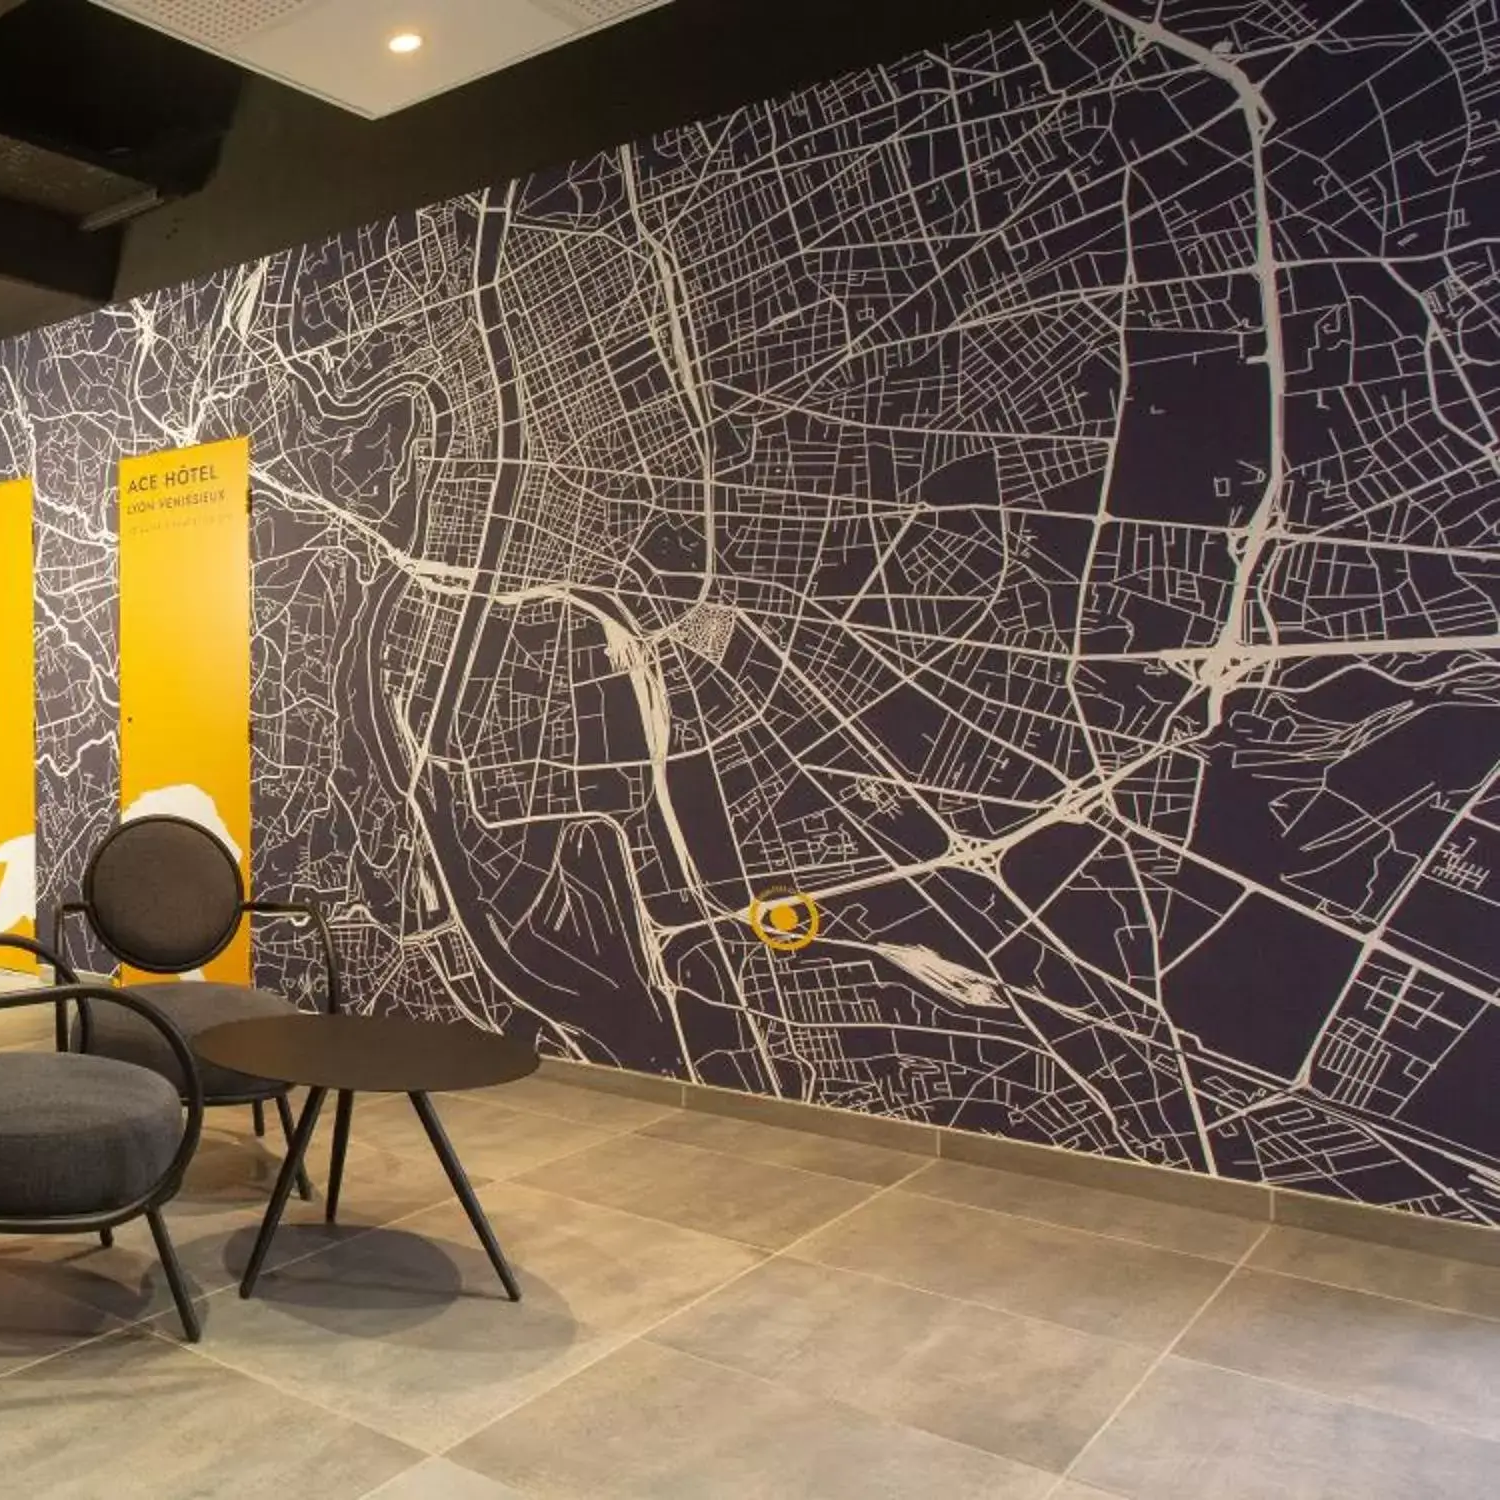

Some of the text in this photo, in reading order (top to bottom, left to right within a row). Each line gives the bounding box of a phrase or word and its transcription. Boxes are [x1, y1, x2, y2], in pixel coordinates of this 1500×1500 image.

[127, 464, 219, 494] ACE HÔTEL
[127, 500, 155, 515] LYON
